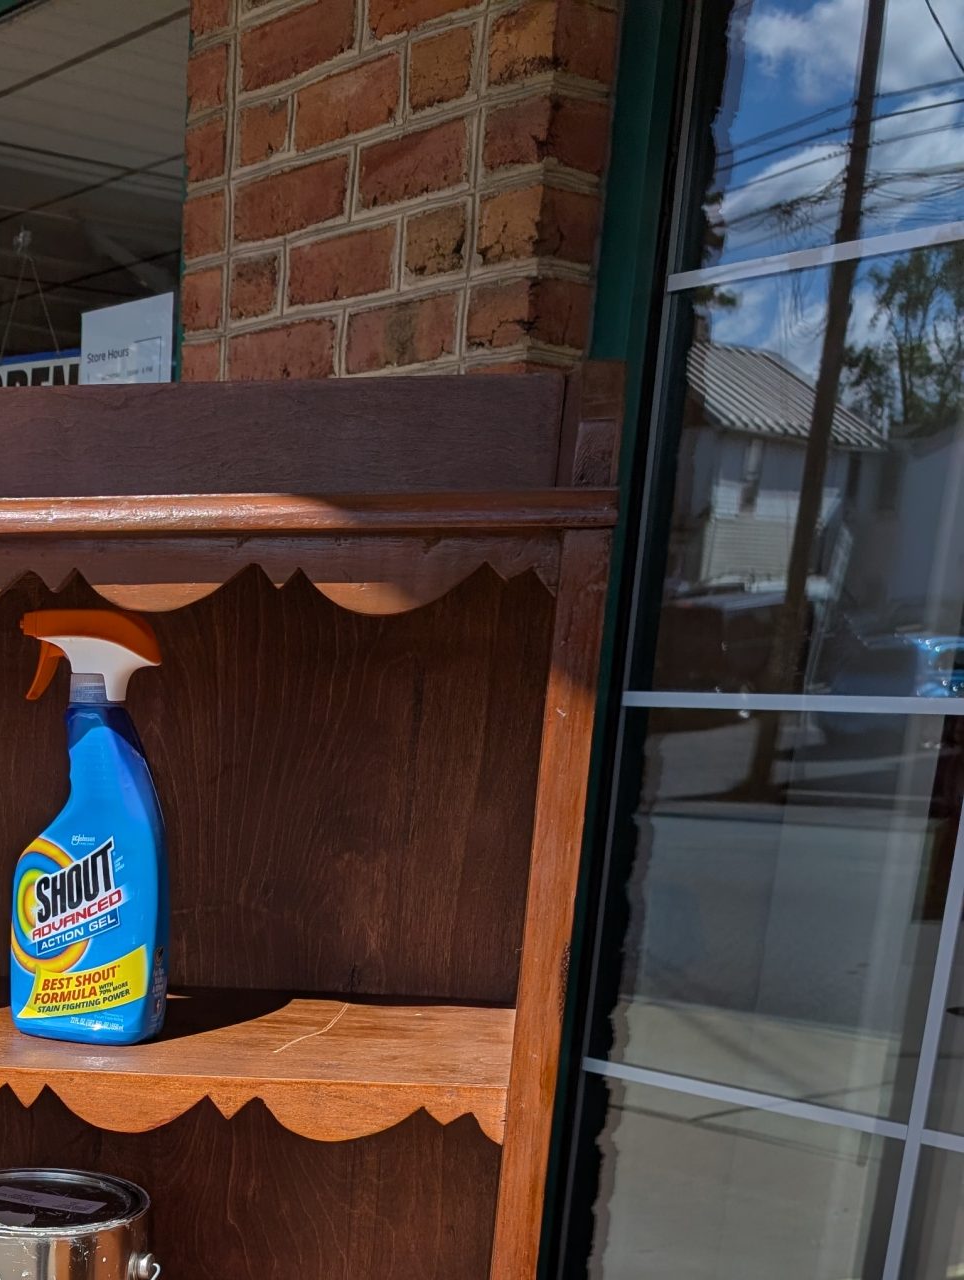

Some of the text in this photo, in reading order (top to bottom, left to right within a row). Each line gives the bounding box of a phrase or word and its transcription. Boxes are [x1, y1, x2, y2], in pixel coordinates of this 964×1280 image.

[87, 348, 129, 363] Store Hours
[36, 841, 113, 923] SHOUT
[32, 889, 122, 940] ADVANCED
[41, 915, 116, 950] ACTION GEL
[42, 977, 73, 991] BEST
[99, 981, 114, 990] WITH
[112, 981, 128, 991] MORE
[34, 987, 98, 1005] FORMULA
[37, 989, 130, 1014] STAIN FIGHTING POWER
